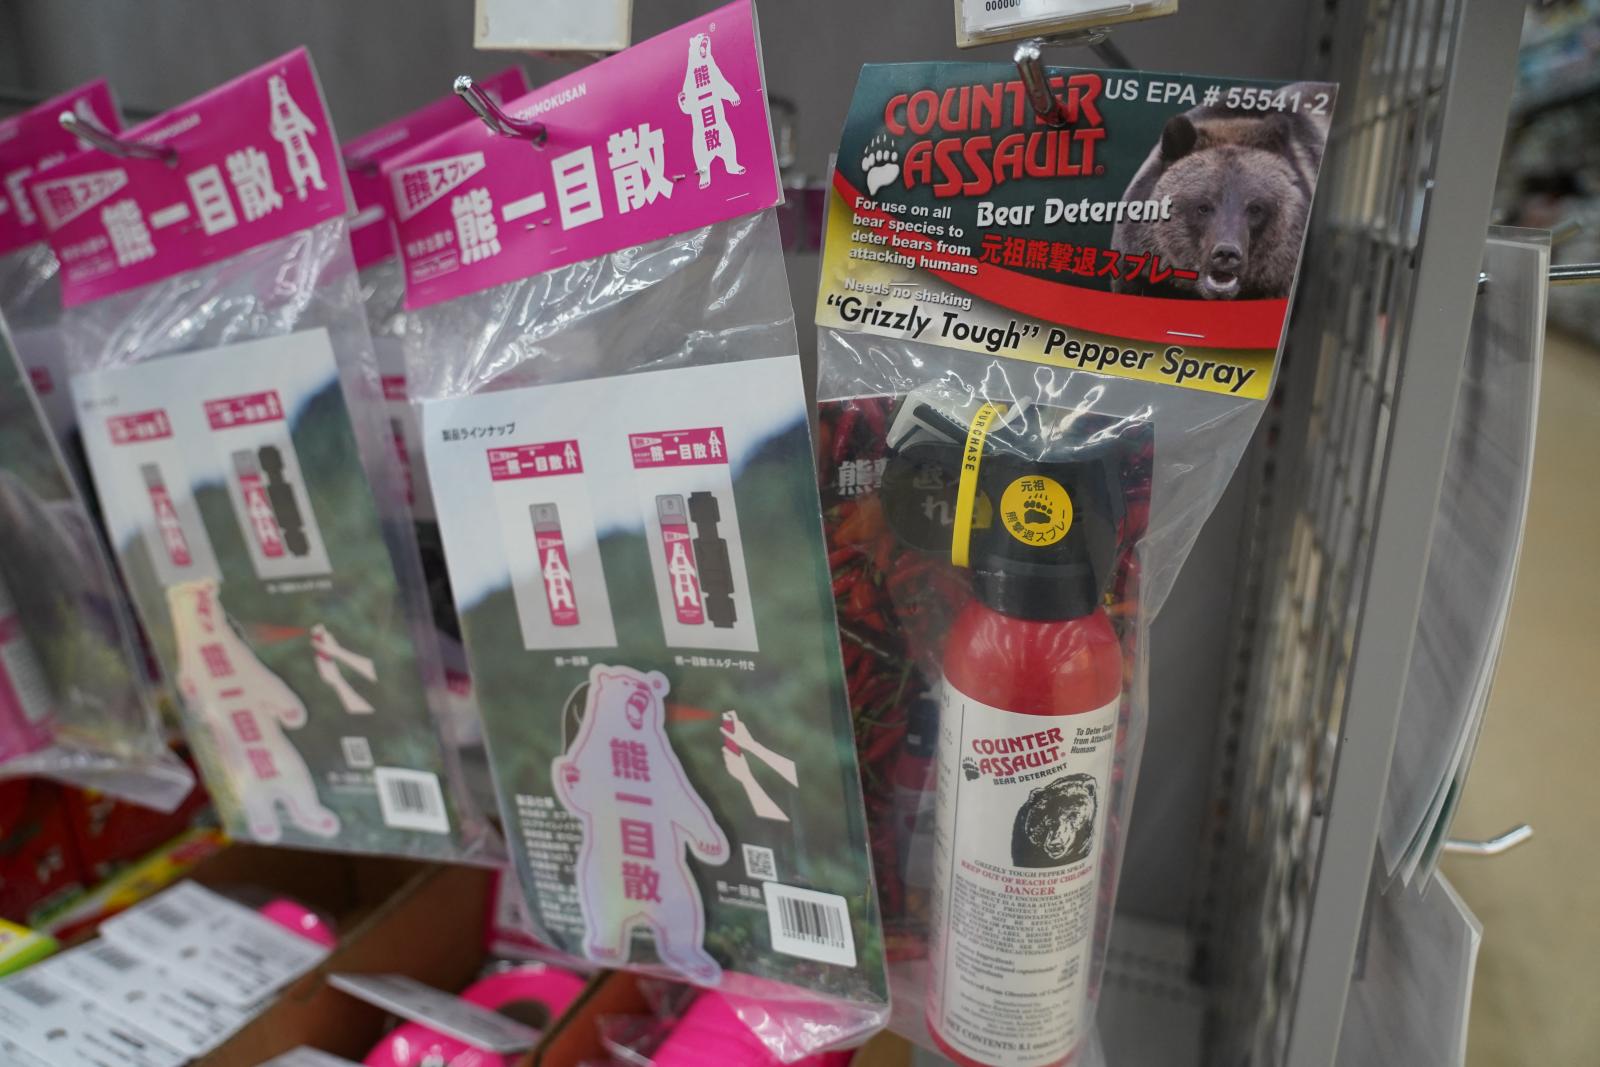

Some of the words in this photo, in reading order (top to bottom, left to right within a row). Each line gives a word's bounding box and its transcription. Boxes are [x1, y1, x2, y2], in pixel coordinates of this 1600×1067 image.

[692, 63, 723, 152] 熊一目散
[1104, 78, 1139, 100] US
[1146, 81, 1197, 106] EPA
[1203, 85, 1221, 108] #
[1225, 87, 1330, 116] 55541-2
[903, 127, 1106, 198] ASSAULT
[450, 121, 676, 266] 熊一目散
[854, 196, 879, 211] For
[881, 200, 907, 214] use
[910, 205, 929, 217] on
[932, 206, 952, 220] all
[852, 213, 886, 229] bear
[888, 219, 945, 237] species
[948, 224, 964, 238] to
[976, 200, 1036, 228] Bear
[1044, 194, 1173, 226] Deterrent
[851, 229, 889, 246] deter
[891, 235, 933, 252] bears
[936, 239, 972, 257] from
[849, 246, 917, 270] attacking
[919, 255, 978, 275] humans
[978, 233, 1200, 285] 元祖熊撃退スプレー
[844, 277, 890, 296] Needs
[892, 286, 912, 300] no
[914, 287, 973, 311] shaking
[1044, 328, 1154, 372] Pepper
[1159, 345, 1257, 394] Spray
[1020, 479, 1046, 492] 元祖
[971, 727, 1065, 756] COUNTER
[979, 745, 1061, 778] ASSAULT
[992, 776, 1017, 786] BEAR
[1018, 762, 1069, 783] DETERRENT
[608, 736, 663, 905] 熊一目散
[1008, 869, 1037, 878] TOUGH
[1038, 869, 1066, 878] PEPPER
[1015, 878, 1046, 886] REACH
[1004, 884, 1056, 896] DANGER
